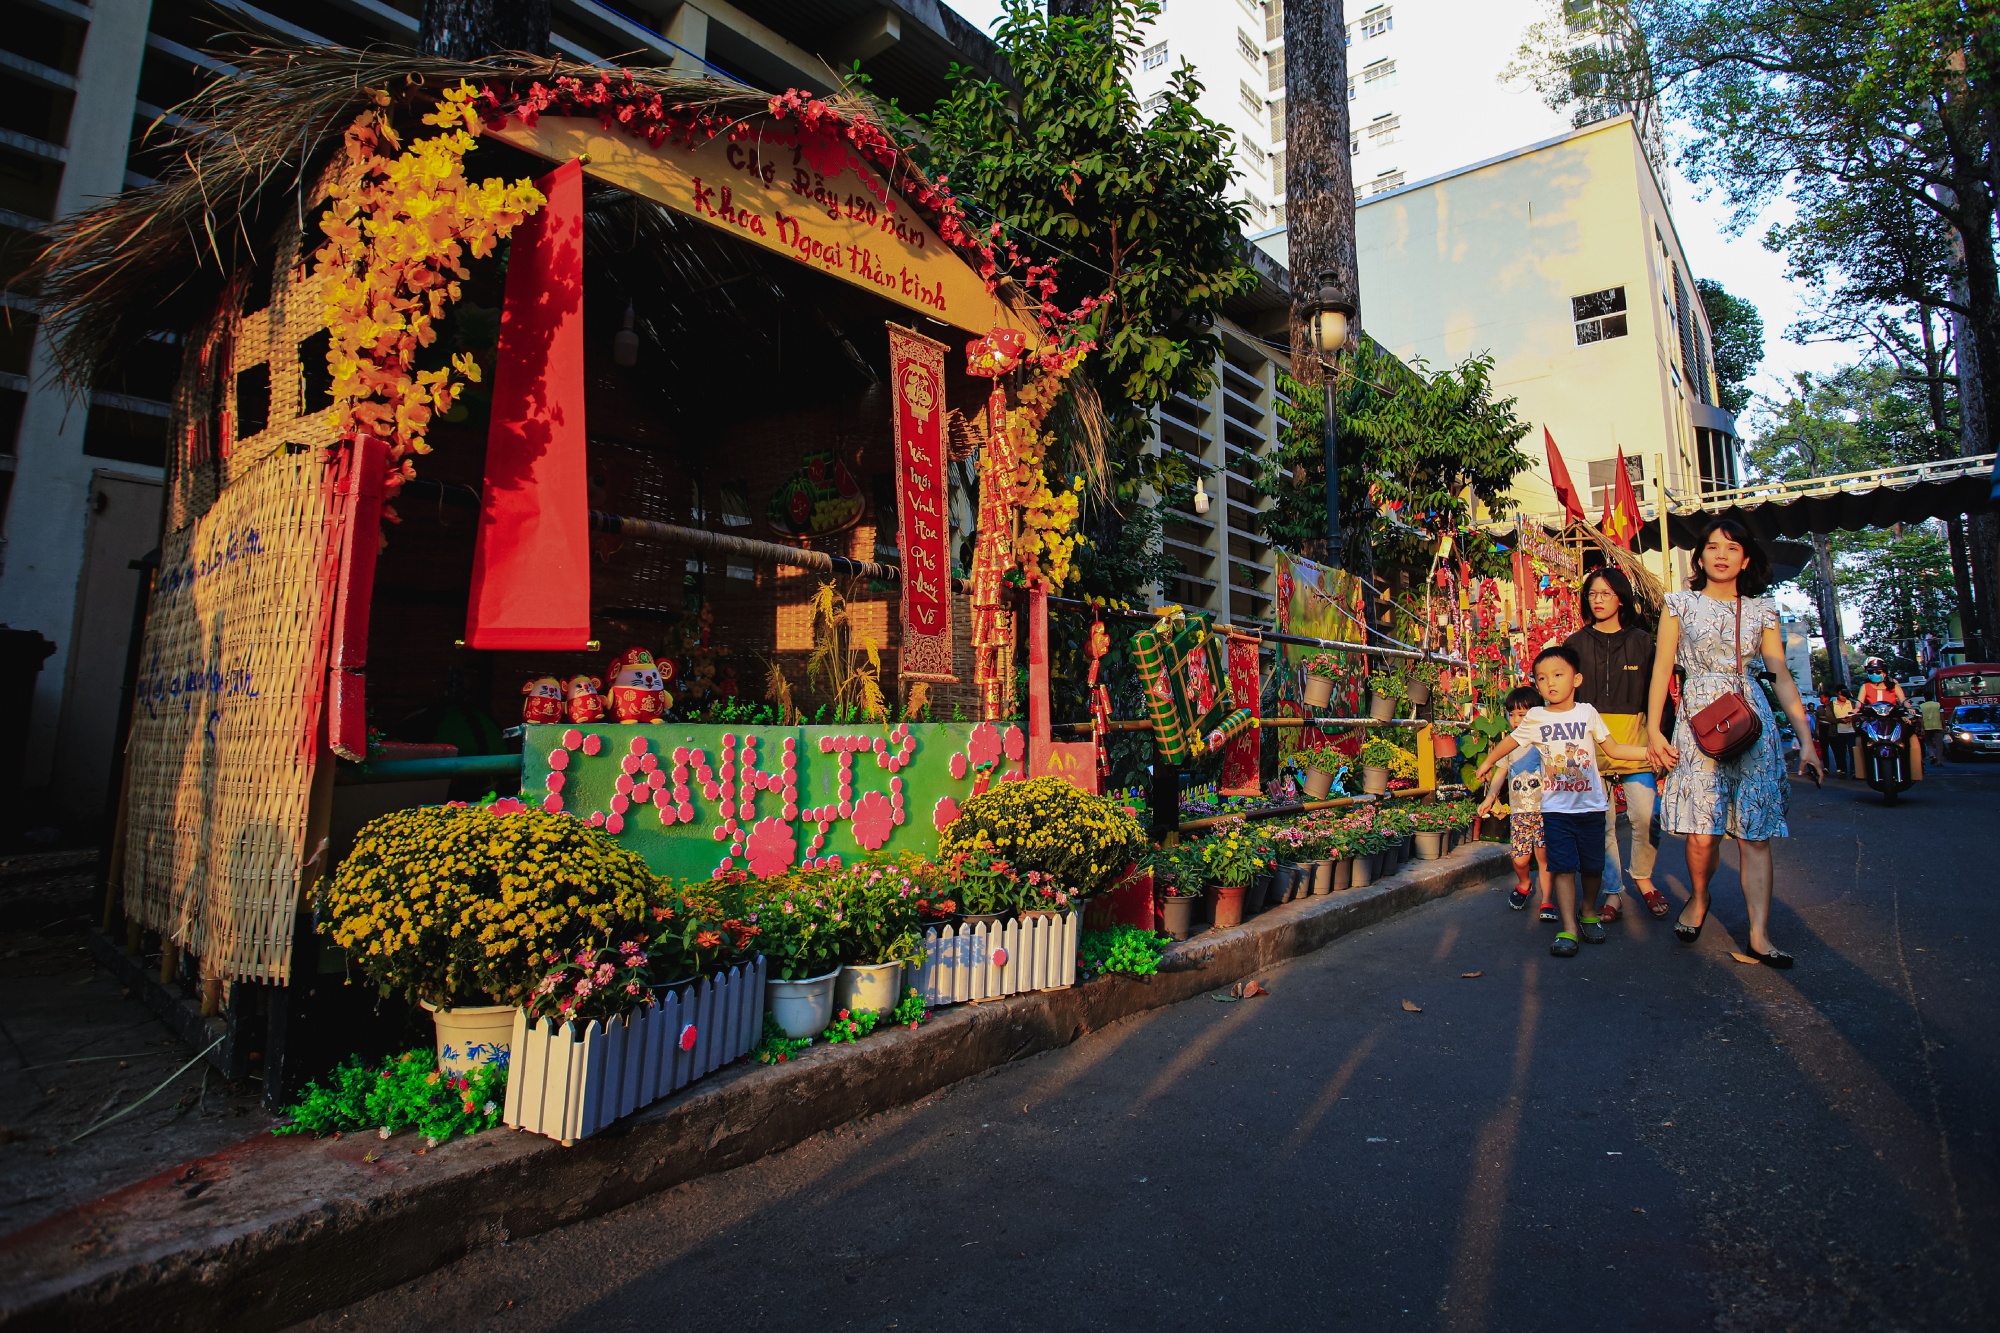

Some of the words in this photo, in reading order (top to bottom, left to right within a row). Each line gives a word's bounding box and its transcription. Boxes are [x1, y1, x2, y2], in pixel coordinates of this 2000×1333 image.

[726, 143, 776, 190] Chợ
[844, 192, 877, 227] 120
[880, 214, 925, 250] năm
[691, 176, 767, 237] Khoa
[775, 210, 844, 270] Ngoại
[907, 490, 940, 517] Vinh
[914, 515, 939, 540] Hoa
[910, 545, 937, 570] Phú
[1539, 721, 1587, 743] PAW
[544, 728, 799, 835] CANH
[1543, 779, 1593, 793] PATROL
